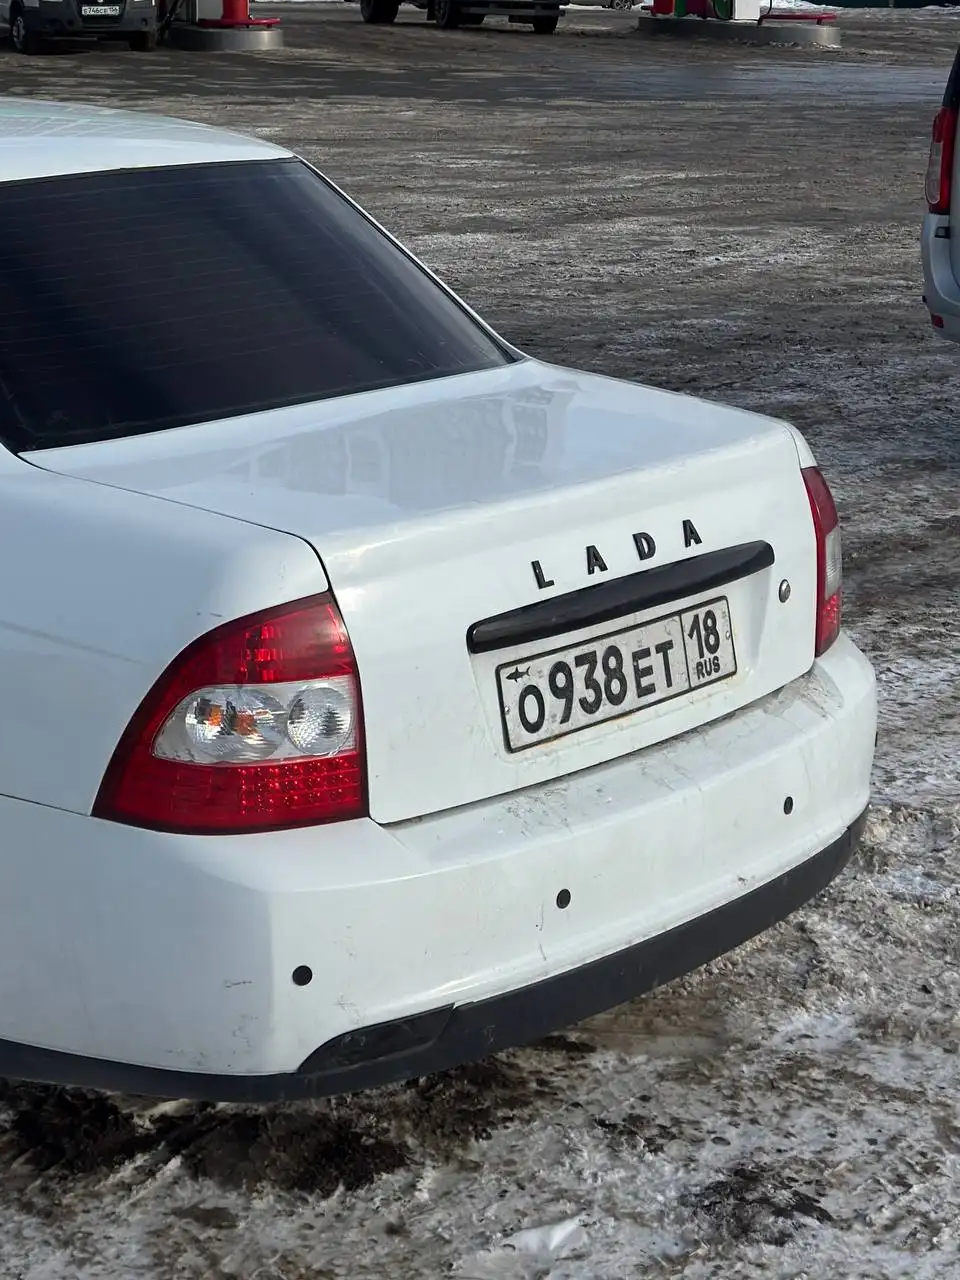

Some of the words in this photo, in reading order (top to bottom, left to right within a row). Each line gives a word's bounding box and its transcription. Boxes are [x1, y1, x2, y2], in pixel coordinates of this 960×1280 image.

[531, 519, 703, 590] LADA
[687, 609, 720, 659] 18
[696, 655, 721, 681] RUS
